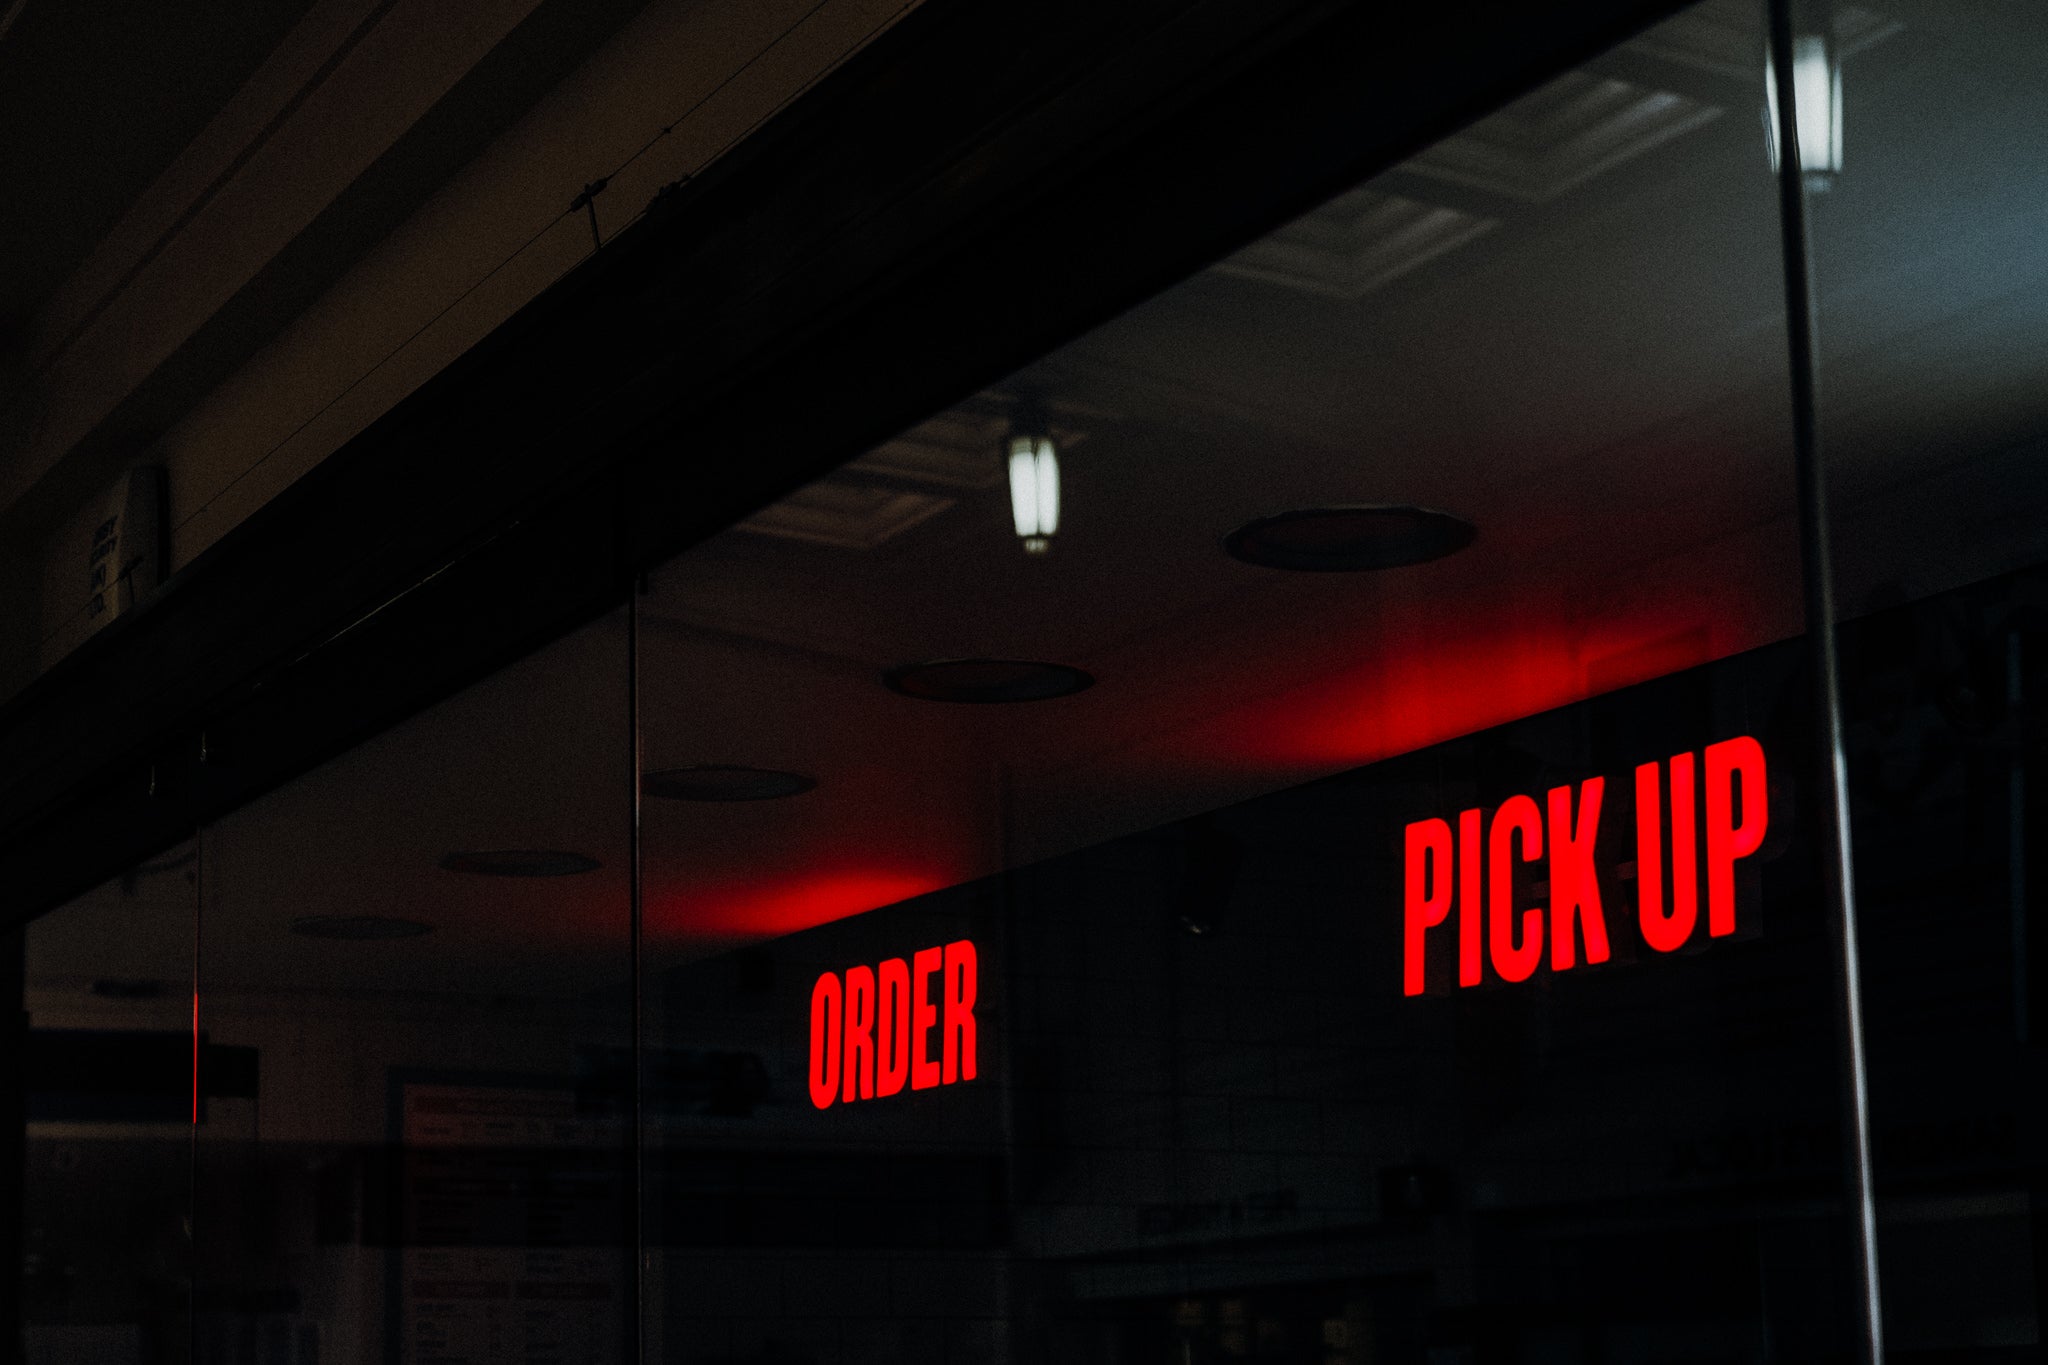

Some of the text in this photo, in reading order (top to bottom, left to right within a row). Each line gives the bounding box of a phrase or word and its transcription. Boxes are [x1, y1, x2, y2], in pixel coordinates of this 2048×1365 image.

[1403, 735, 1770, 997] PICK UP
[809, 939, 979, 1110] ORDER
